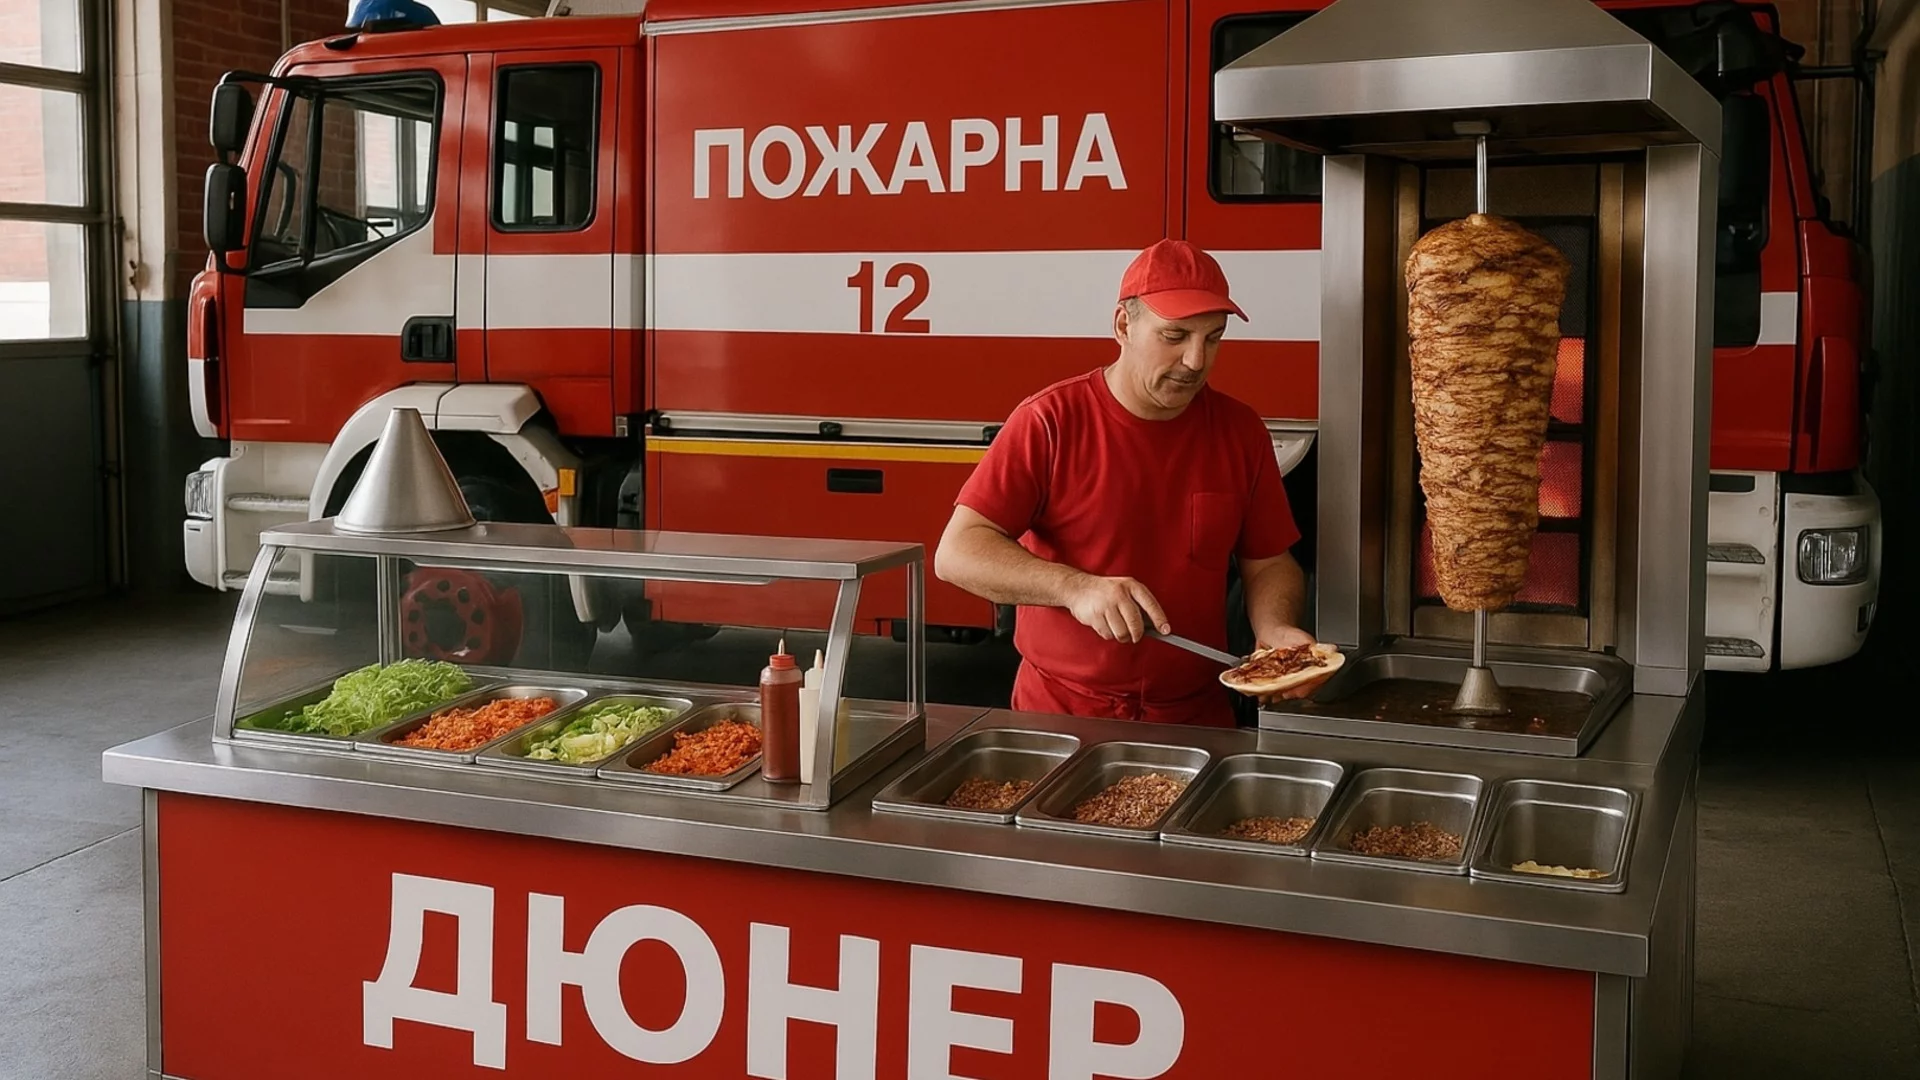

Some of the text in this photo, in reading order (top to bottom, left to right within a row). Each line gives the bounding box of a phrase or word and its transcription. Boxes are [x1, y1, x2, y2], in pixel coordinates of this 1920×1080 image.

[693, 112, 1128, 200] ПОЖАРНА
[847, 261, 931, 333] 12
[362, 872, 1185, 1080] ДЮНЕР
